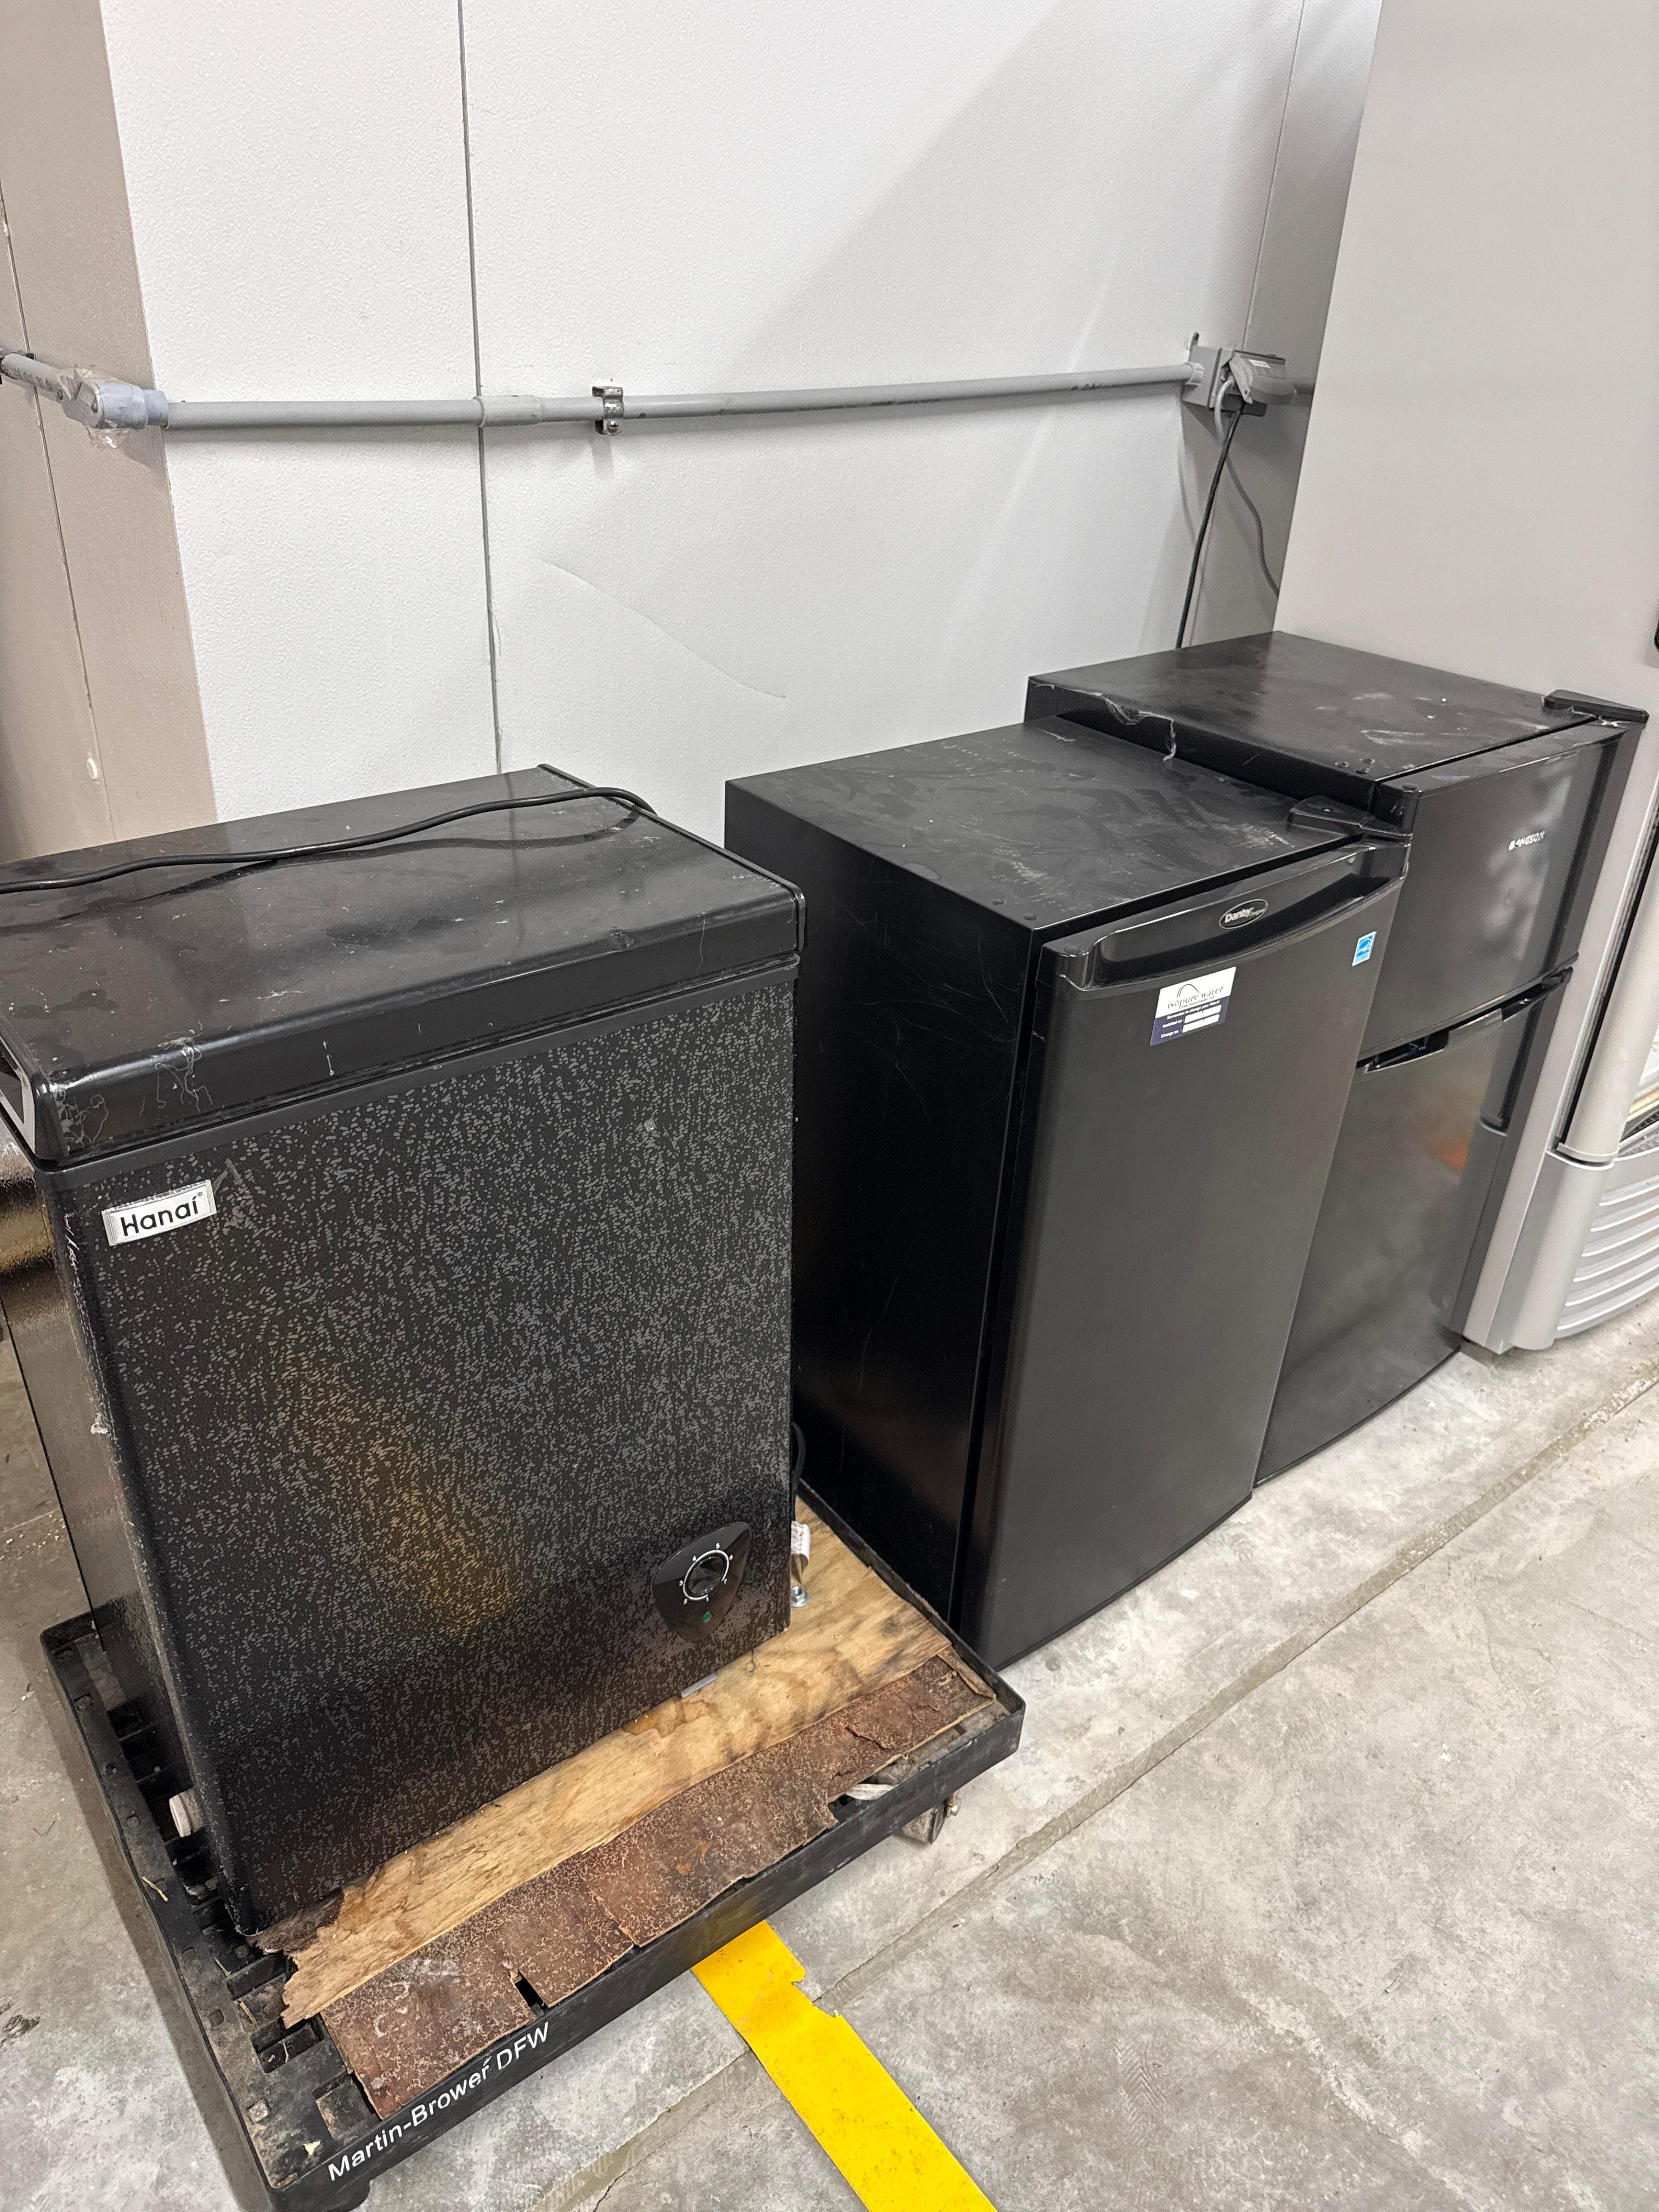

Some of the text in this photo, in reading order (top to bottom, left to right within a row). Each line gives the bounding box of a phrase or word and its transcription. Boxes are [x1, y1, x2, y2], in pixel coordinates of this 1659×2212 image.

[1224, 907, 1254, 923] Danby
[1201, 986, 1224, 998] water
[328, 2021, 550, 2182] Martin-Brower DFW
